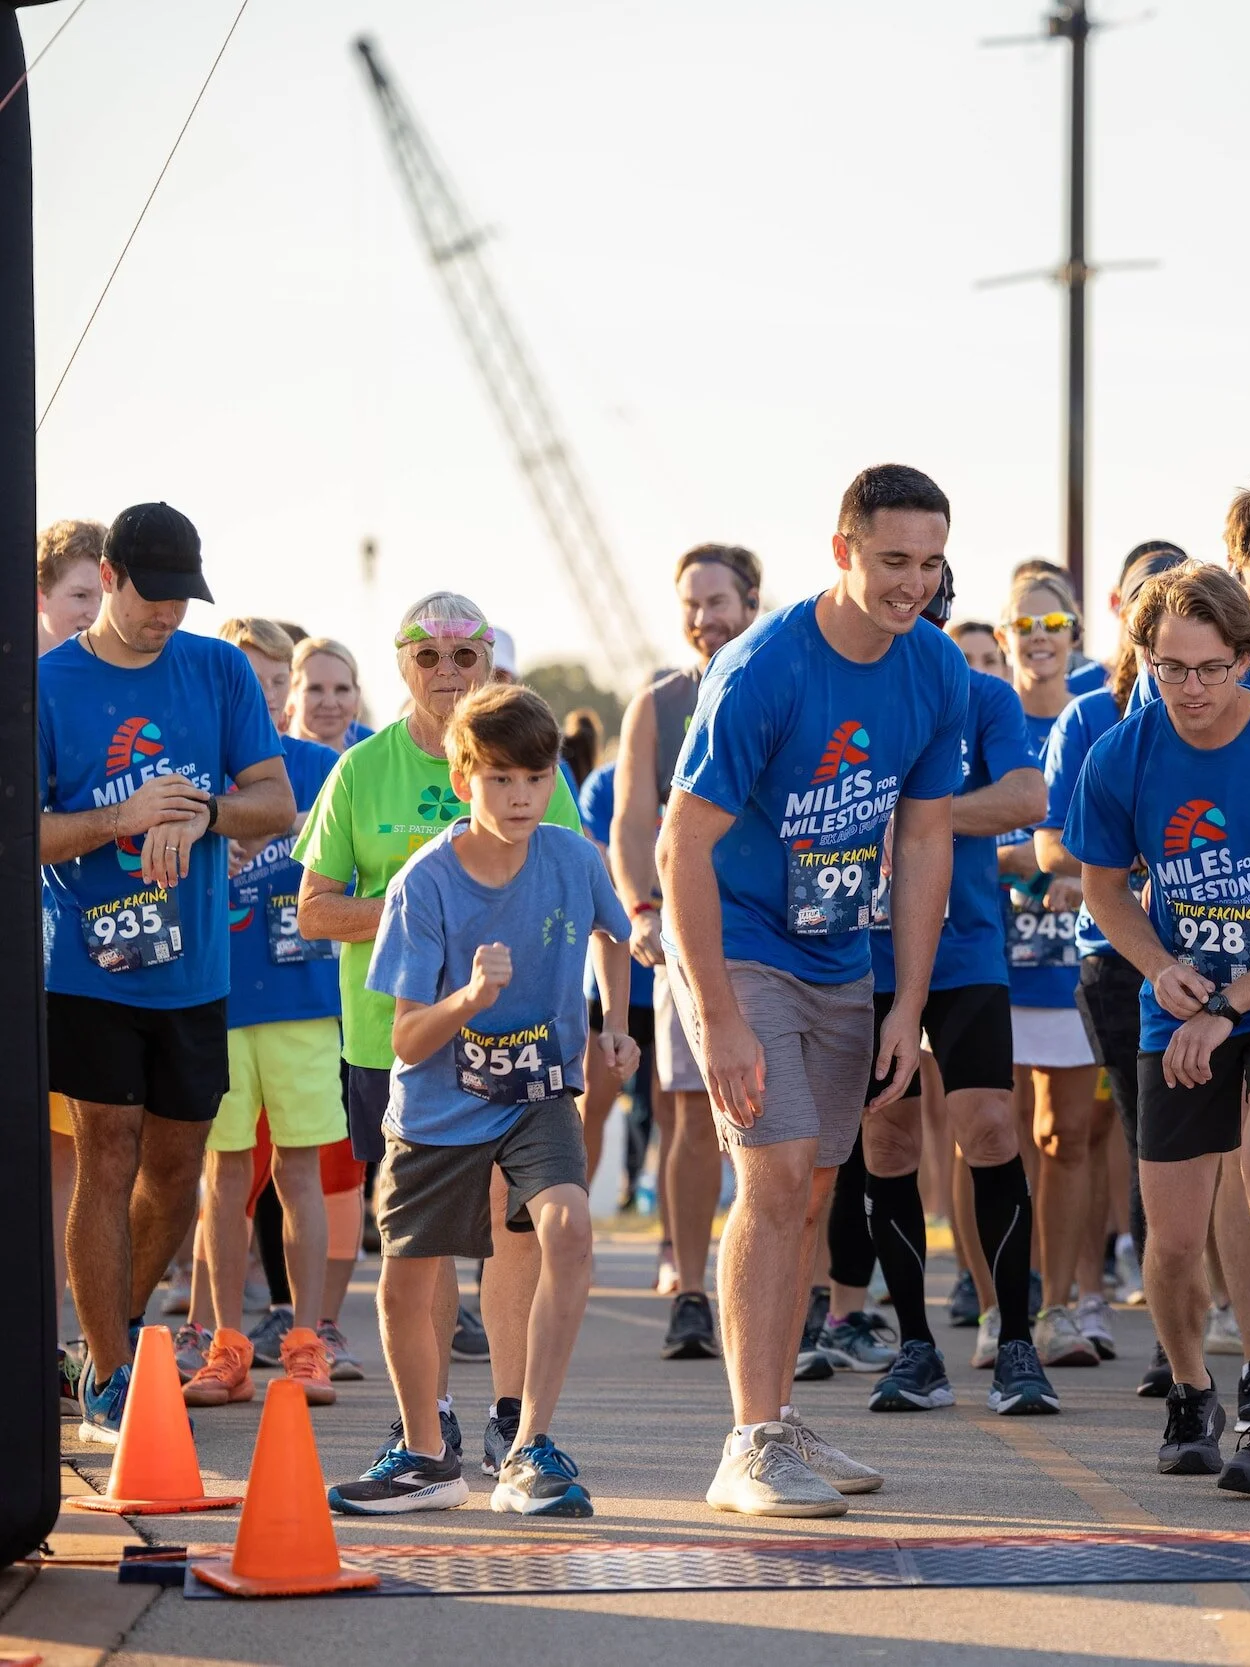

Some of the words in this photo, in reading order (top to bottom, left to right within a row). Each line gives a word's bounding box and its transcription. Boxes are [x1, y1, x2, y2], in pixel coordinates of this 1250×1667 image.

[784, 769, 873, 818] MILES
[876, 776, 898, 792] FOR
[409, 824, 446, 834] PATRIC
[780, 790, 900, 838] MILESTONE
[798, 852, 840, 867] TATUR
[841, 844, 877, 865] RACING
[1156, 848, 1233, 887] MILES
[817, 864, 863, 899] 99
[86, 900, 121, 921] TATUR
[124, 887, 168, 910] RACING
[271, 895, 298, 908] TATU
[1174, 902, 1206, 918] TATUR
[94, 904, 162, 946] 935
[1015, 912, 1075, 940] 943
[1179, 917, 1245, 954] 928
[460, 1026, 495, 1047] TATUR
[498, 1024, 548, 1048] RACING
[464, 1041, 542, 1076] 954
